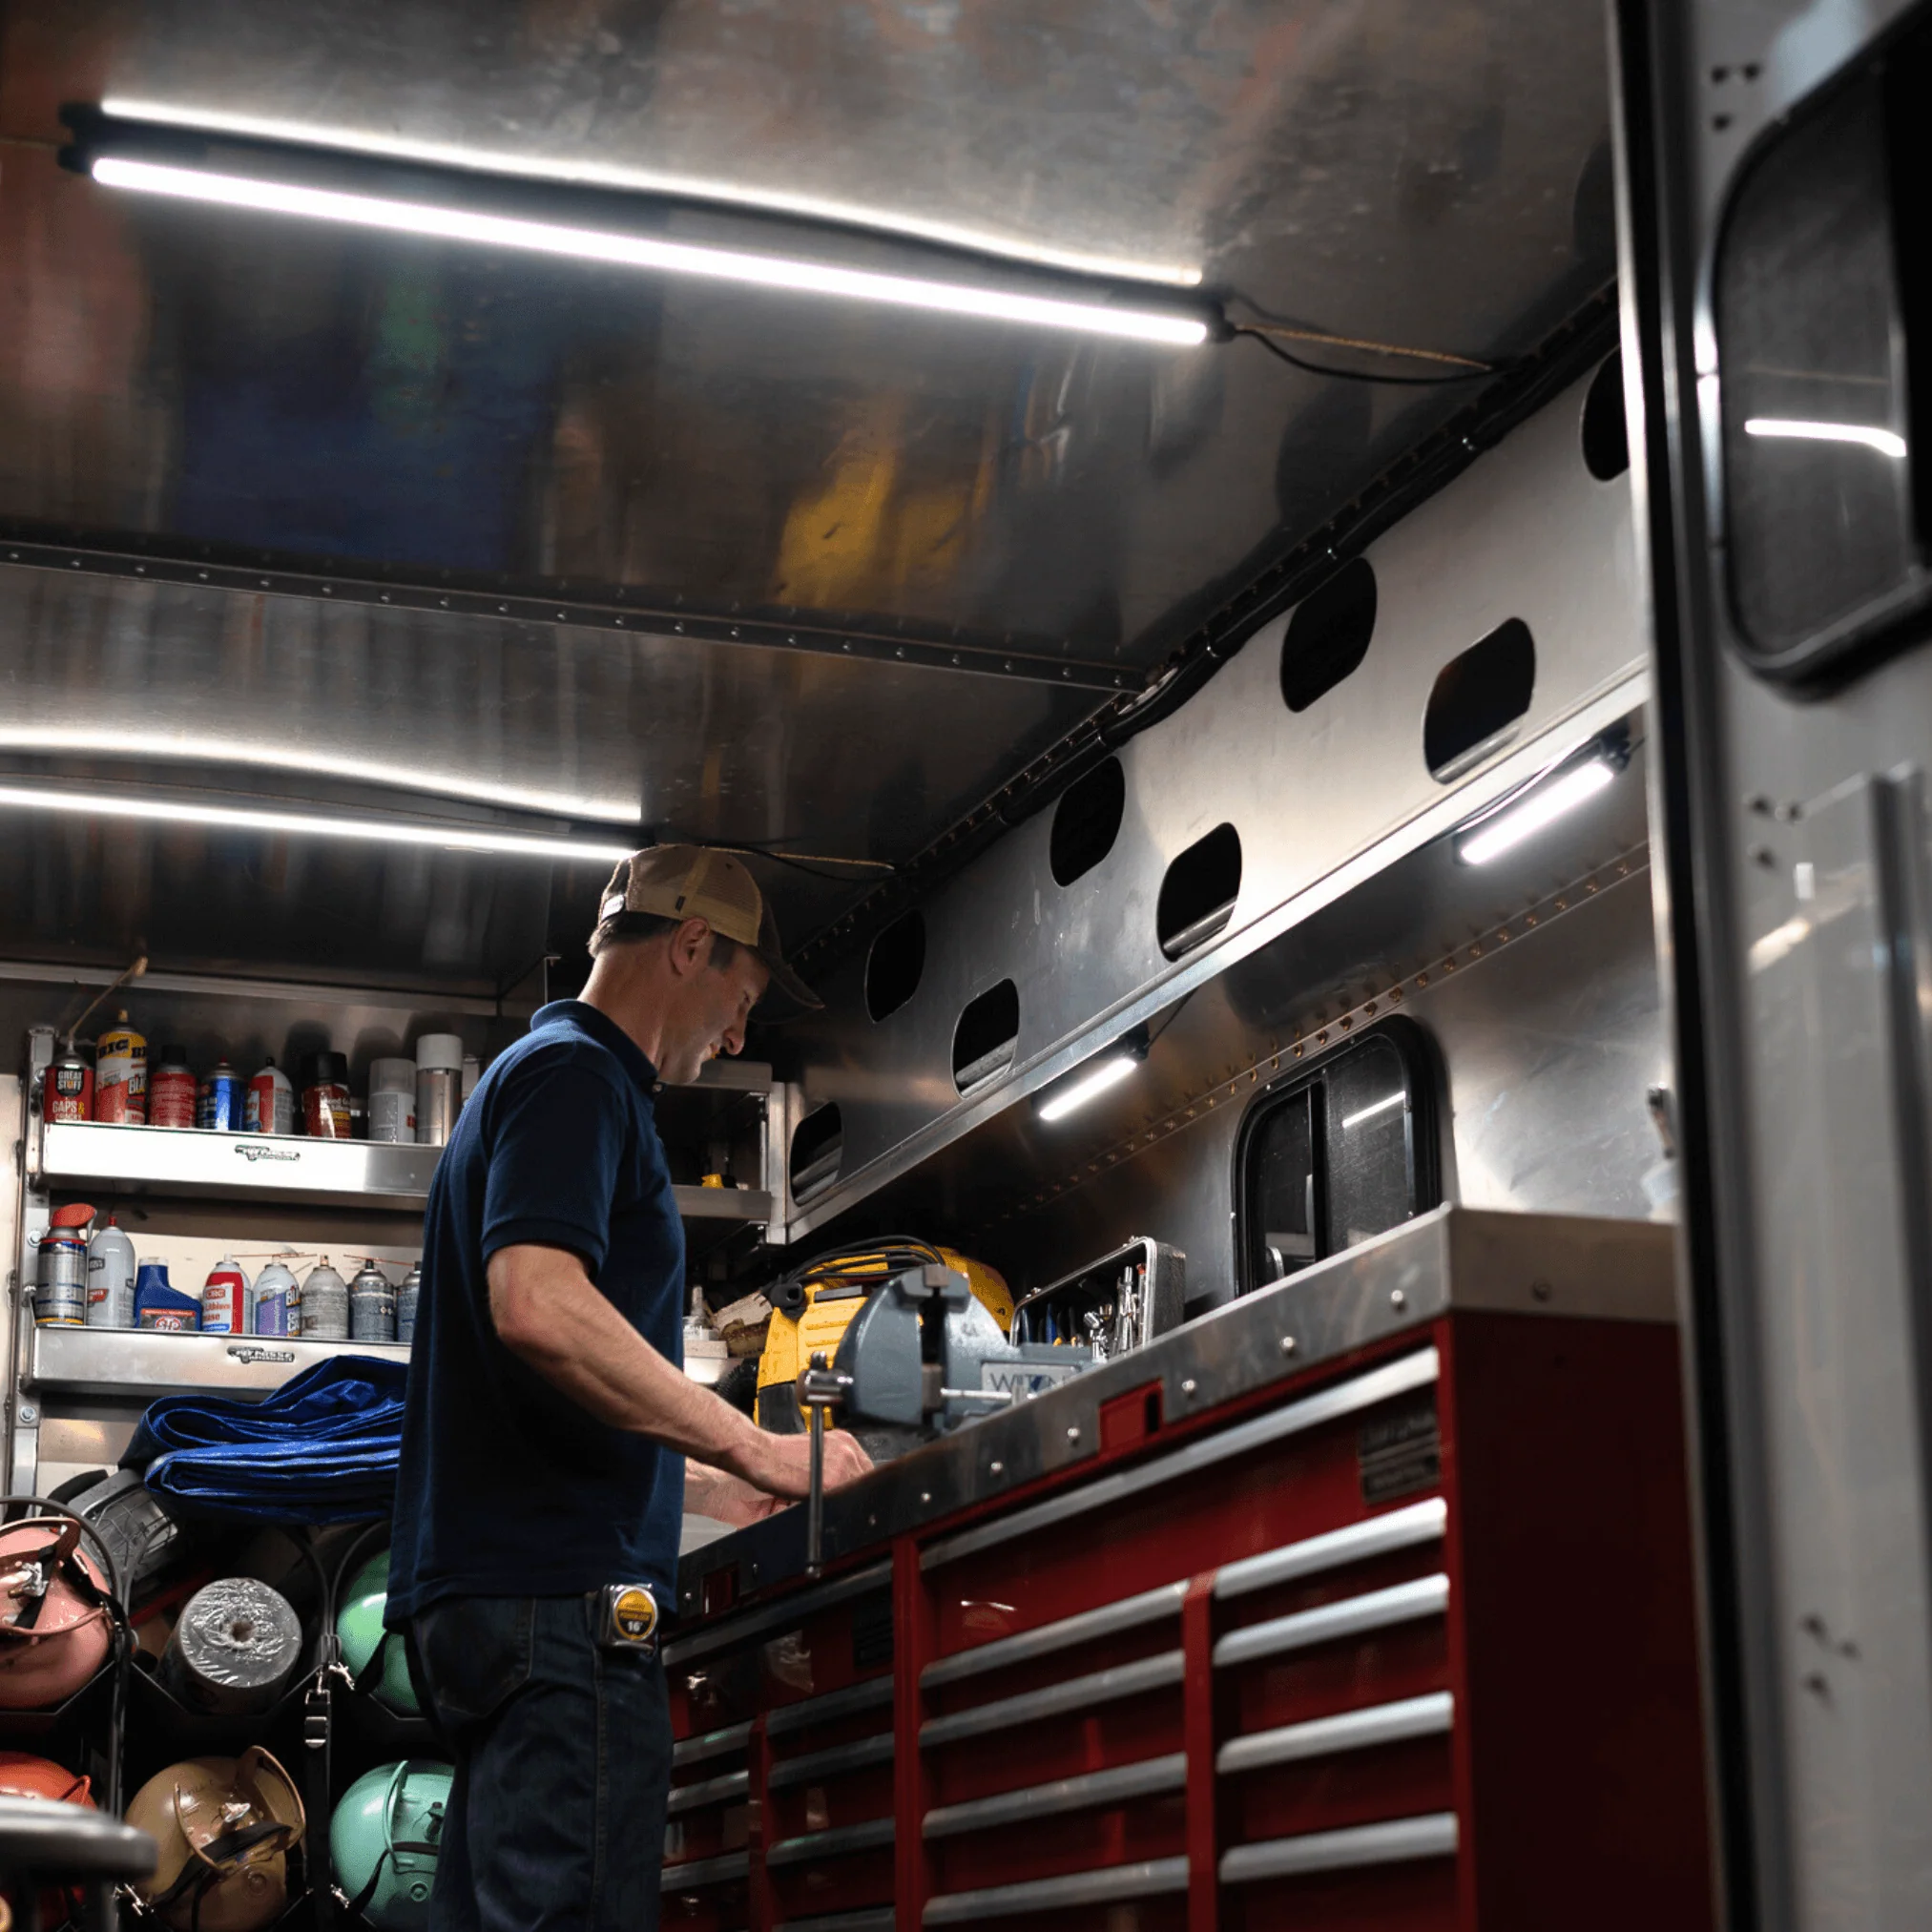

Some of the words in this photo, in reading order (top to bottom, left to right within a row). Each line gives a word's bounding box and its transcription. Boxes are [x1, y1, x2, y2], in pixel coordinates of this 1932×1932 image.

[57, 1070, 83, 1080] GREAT
[57, 1080, 83, 1091] STUFF
[52, 1100, 78, 1113] GAPS
